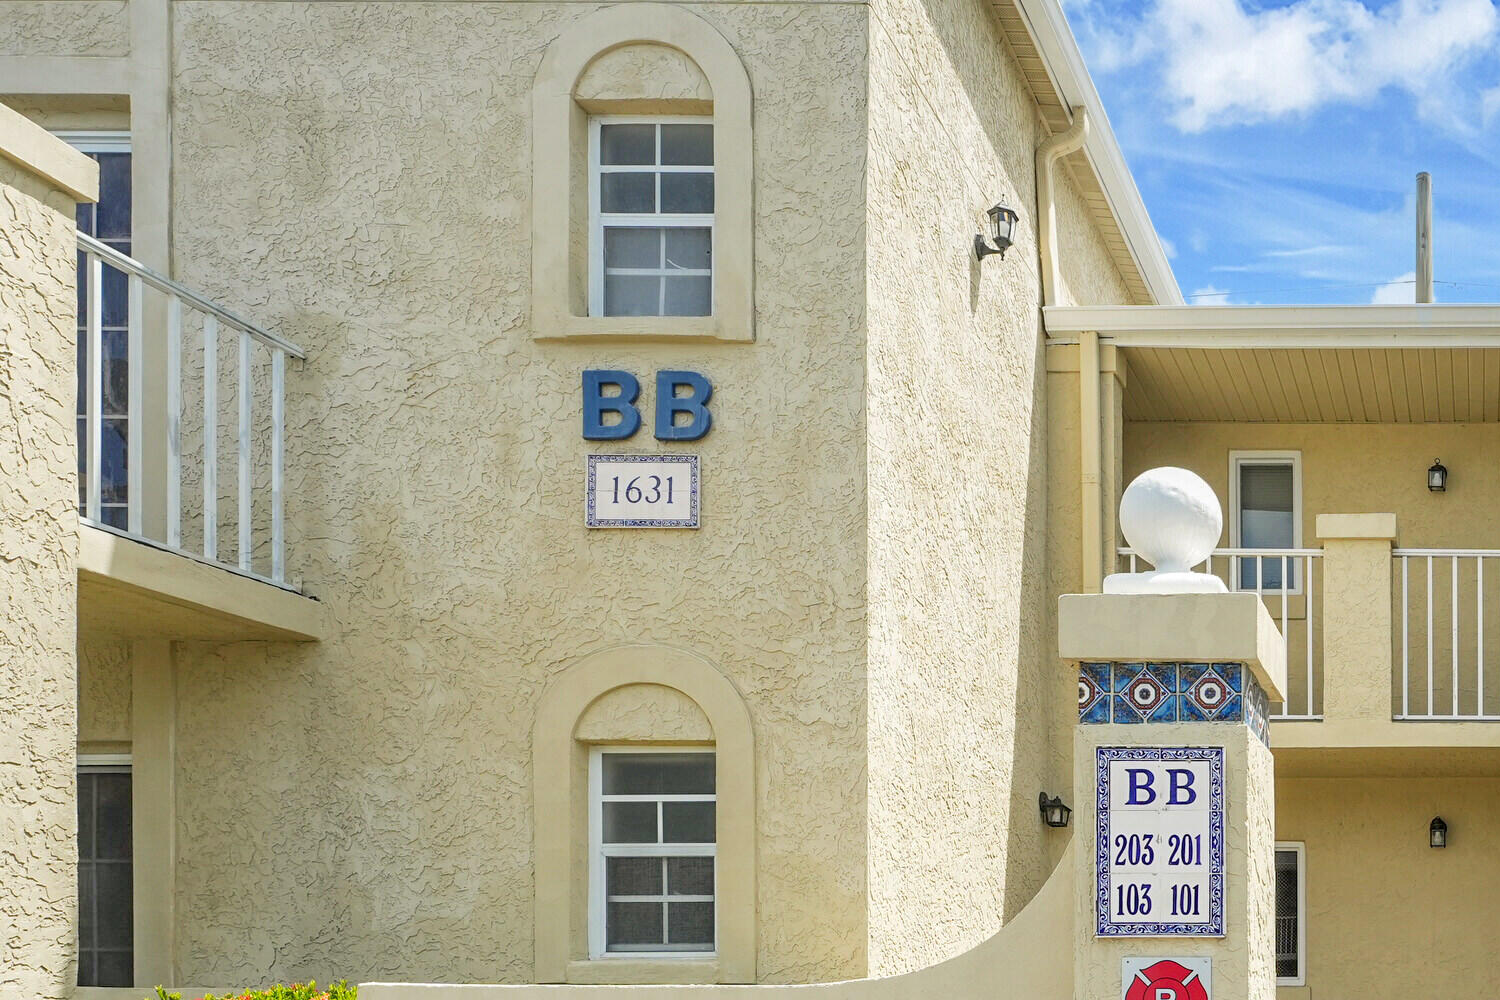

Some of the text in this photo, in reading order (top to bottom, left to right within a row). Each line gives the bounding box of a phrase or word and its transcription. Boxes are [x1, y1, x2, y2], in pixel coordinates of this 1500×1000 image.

[582, 370, 712, 440] BB
[612, 475, 674, 504] 1631
[1125, 769, 1197, 806] BB
[1115, 834, 1202, 866] 203 201
[1116, 884, 1200, 916] 103 101
